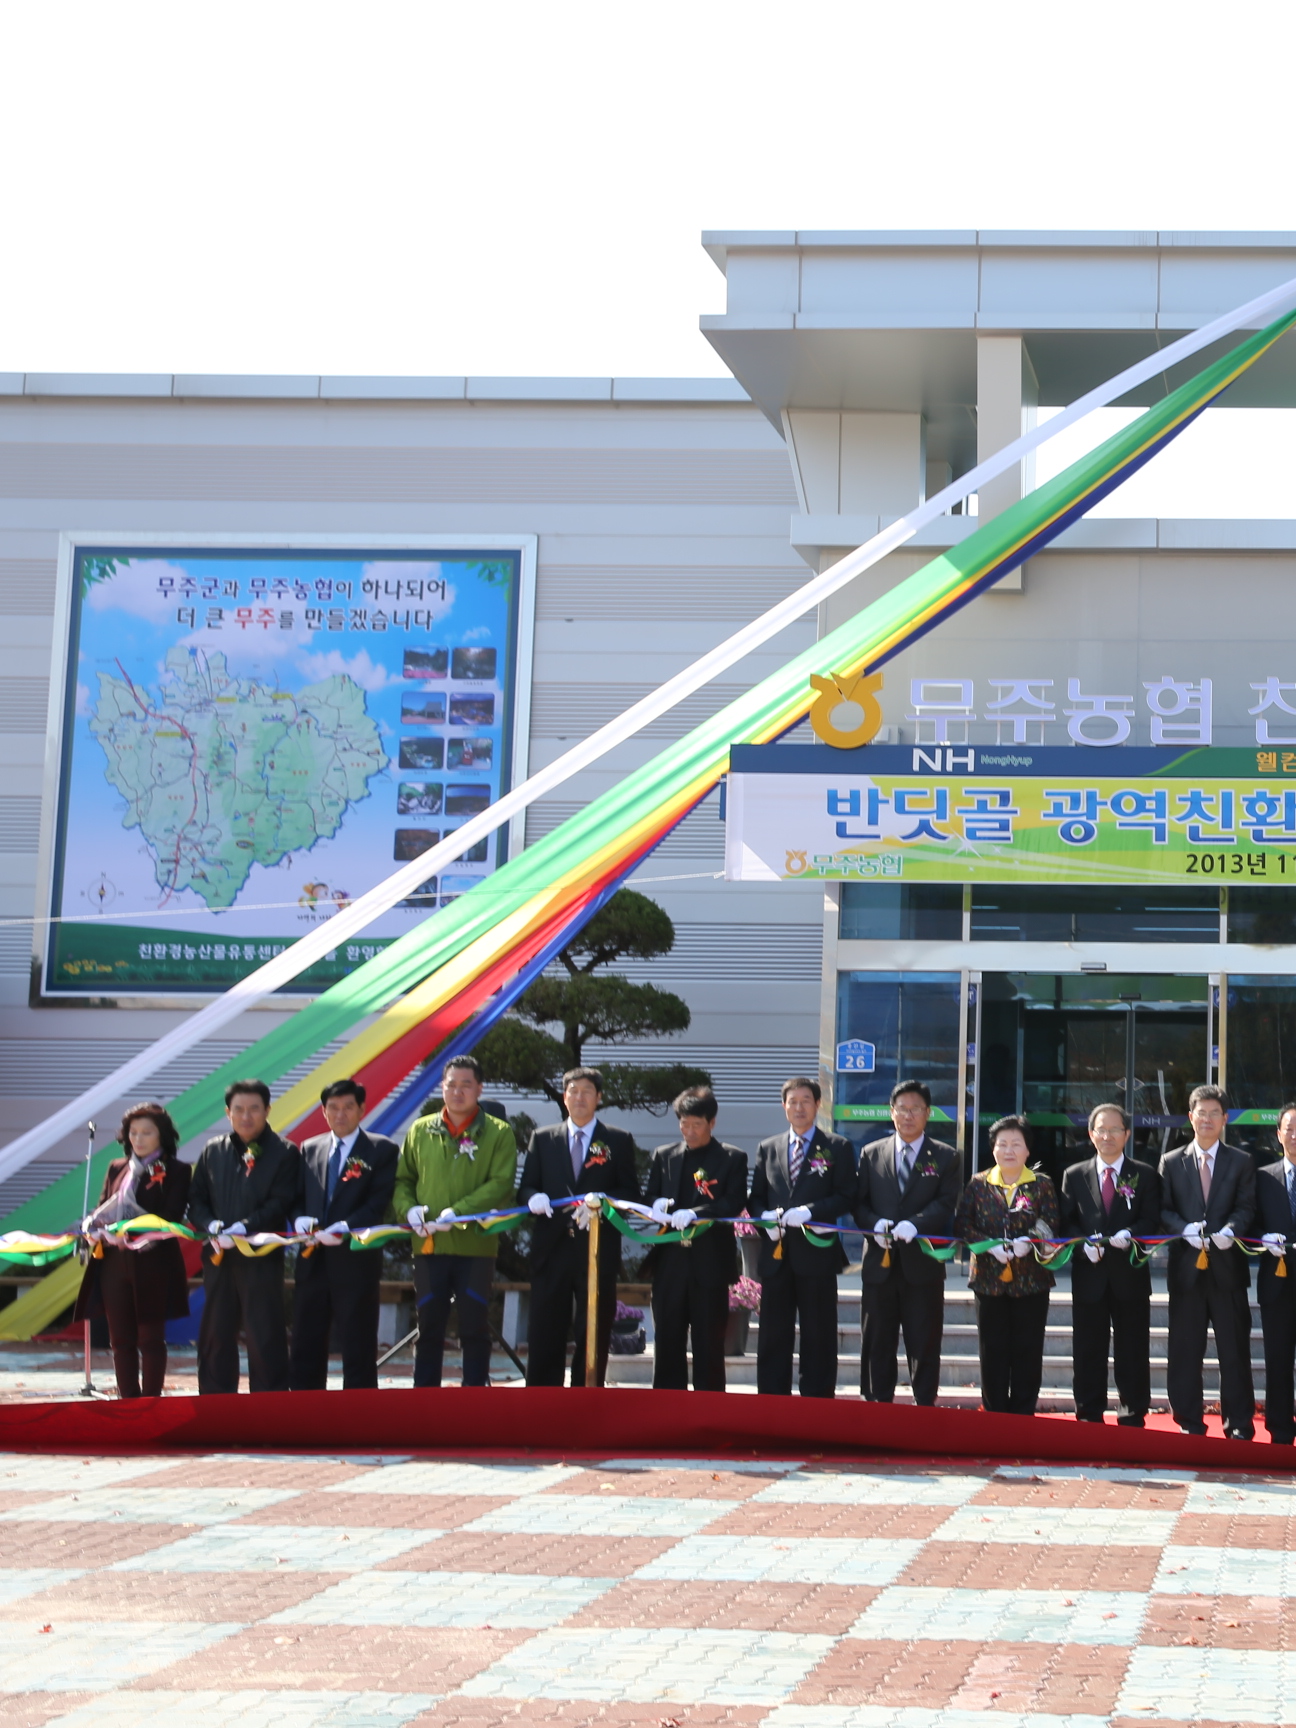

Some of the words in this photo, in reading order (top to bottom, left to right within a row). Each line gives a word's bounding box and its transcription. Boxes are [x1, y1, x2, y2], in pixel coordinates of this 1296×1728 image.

[156, 577, 240, 600] 무주군과
[248, 577, 353, 601] 무주농협이
[362, 578, 447, 601] 하나되어
[177, 607, 196, 629] 더
[205, 607, 225, 630] 큰
[234, 607, 295, 630] 무주를
[304, 608, 434, 632] 만들겠습니다
[905, 676, 1213, 747] 무주농협
[912, 748, 976, 772] NH
[980, 754, 1033, 767] NongHyup
[826, 787, 1020, 842] 반딧골
[811, 854, 903, 876] 무주농협
[1185, 852, 1268, 876] 2013년
[845, 1055, 866, 1069] 26
[1142, 1117, 1161, 1125] NH
